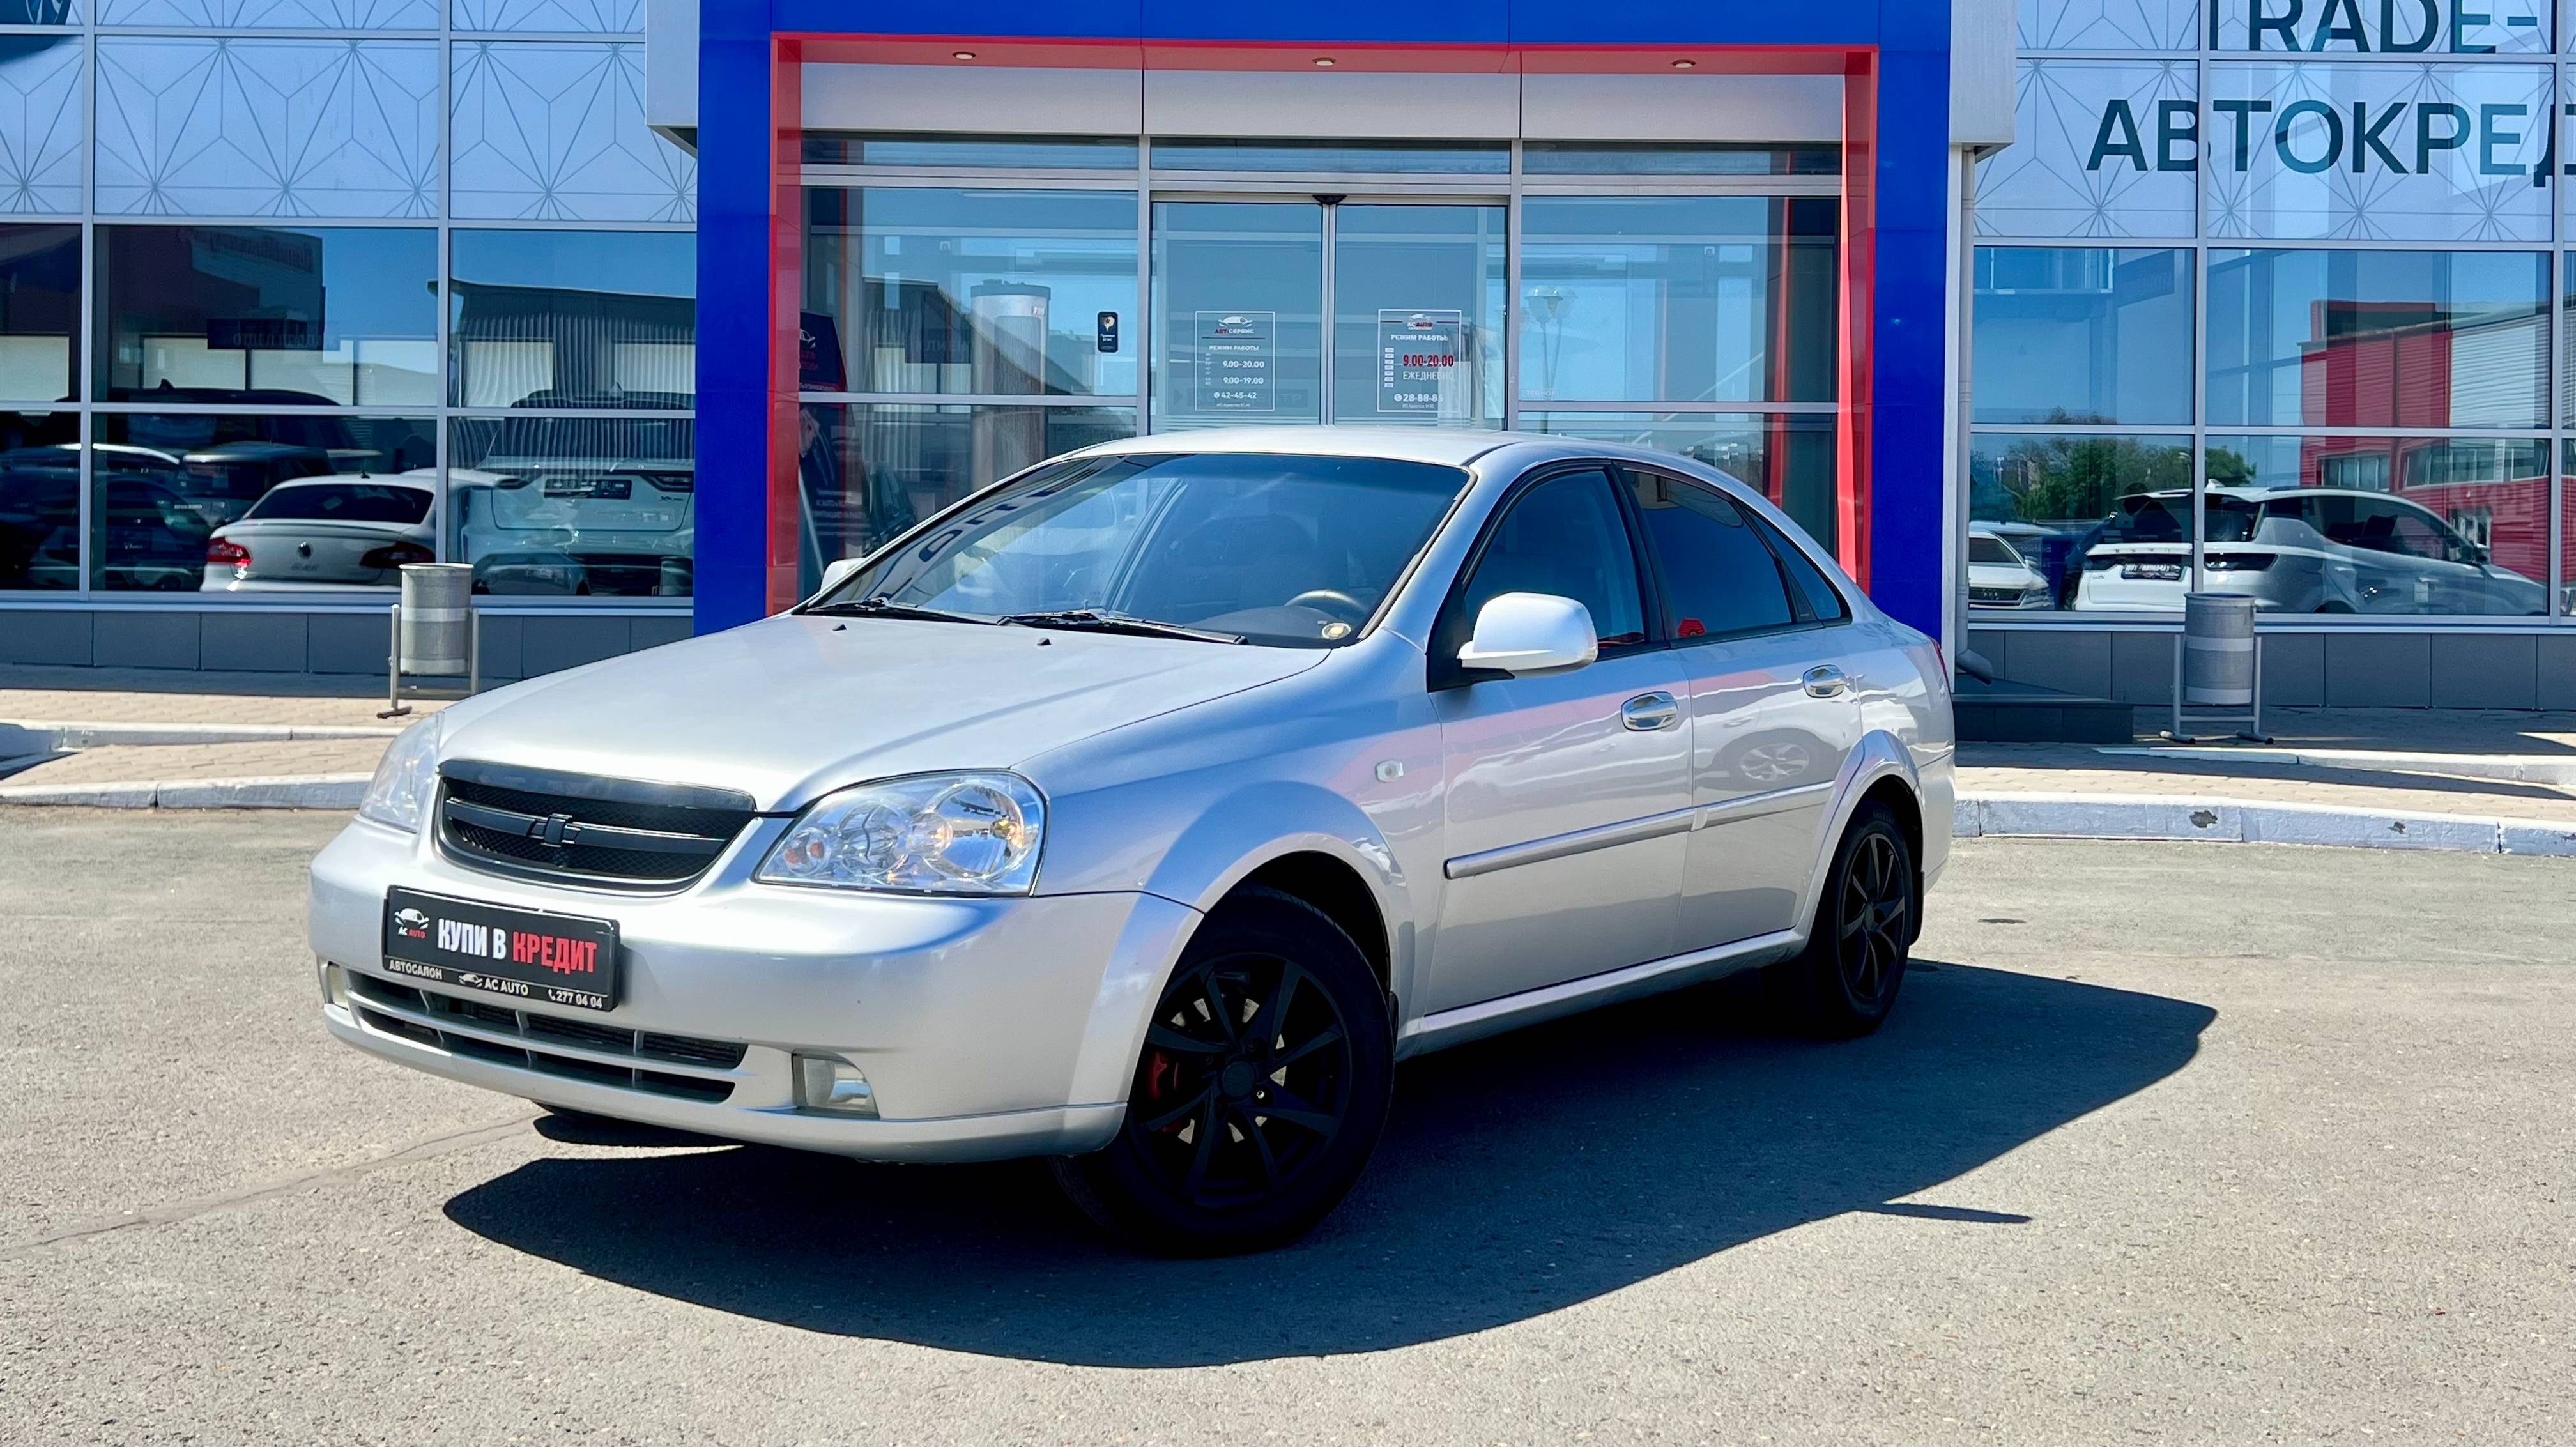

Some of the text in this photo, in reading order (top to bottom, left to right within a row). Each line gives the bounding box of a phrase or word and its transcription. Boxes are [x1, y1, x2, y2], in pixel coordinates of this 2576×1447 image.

[1222, 360, 1265, 369] 9.00-20.00
[1403, 354, 1453, 367] 9.00-20.00
[1223, 376, 1264, 385] 9.00-19.00
[1403, 371, 1454, 381] ЕЖЕДНЕВНО
[1221, 391, 1257, 399] 42-45-42
[397, 926, 427, 939] AC AUTO
[438, 918, 598, 975] КУПИ В КРЕДИТ
[389, 960, 603, 1009] АВТОСАЛОН AC AUTO 277 04 04
